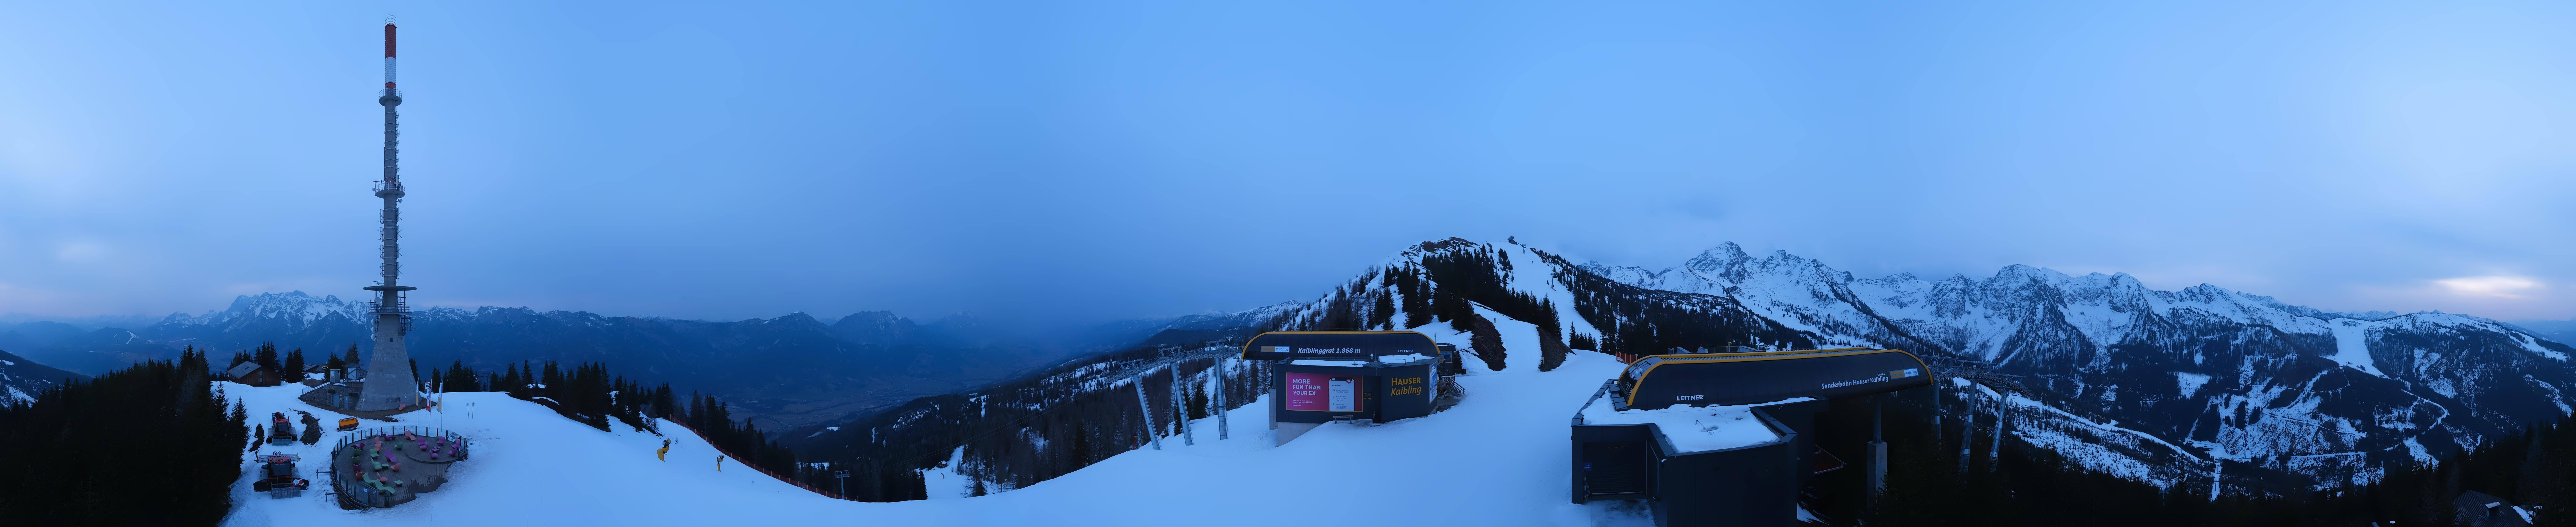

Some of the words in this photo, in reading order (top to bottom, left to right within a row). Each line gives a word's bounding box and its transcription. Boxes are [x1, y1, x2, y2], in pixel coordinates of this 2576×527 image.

[1391, 377, 1421, 386] HAUSER
[1821, 380, 1852, 389] Senderbahn
[1391, 386, 1421, 396] Kaibling
